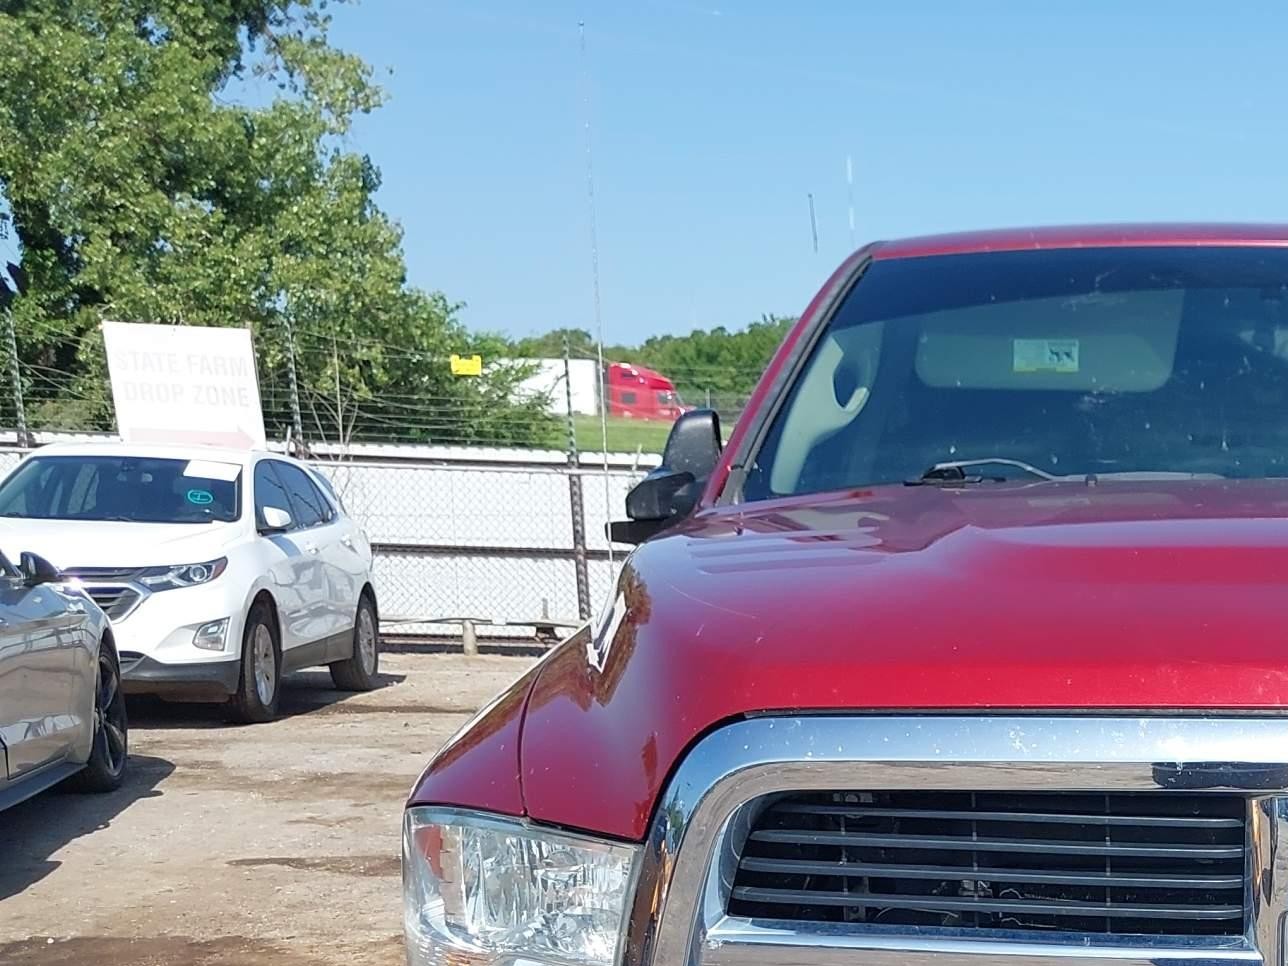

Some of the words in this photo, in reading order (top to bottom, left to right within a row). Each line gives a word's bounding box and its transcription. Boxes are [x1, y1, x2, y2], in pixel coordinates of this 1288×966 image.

[113, 350, 180, 374] STATE
[186, 352, 249, 377] FARM
[123, 380, 185, 404] DROP
[191, 383, 251, 408] ZONE
